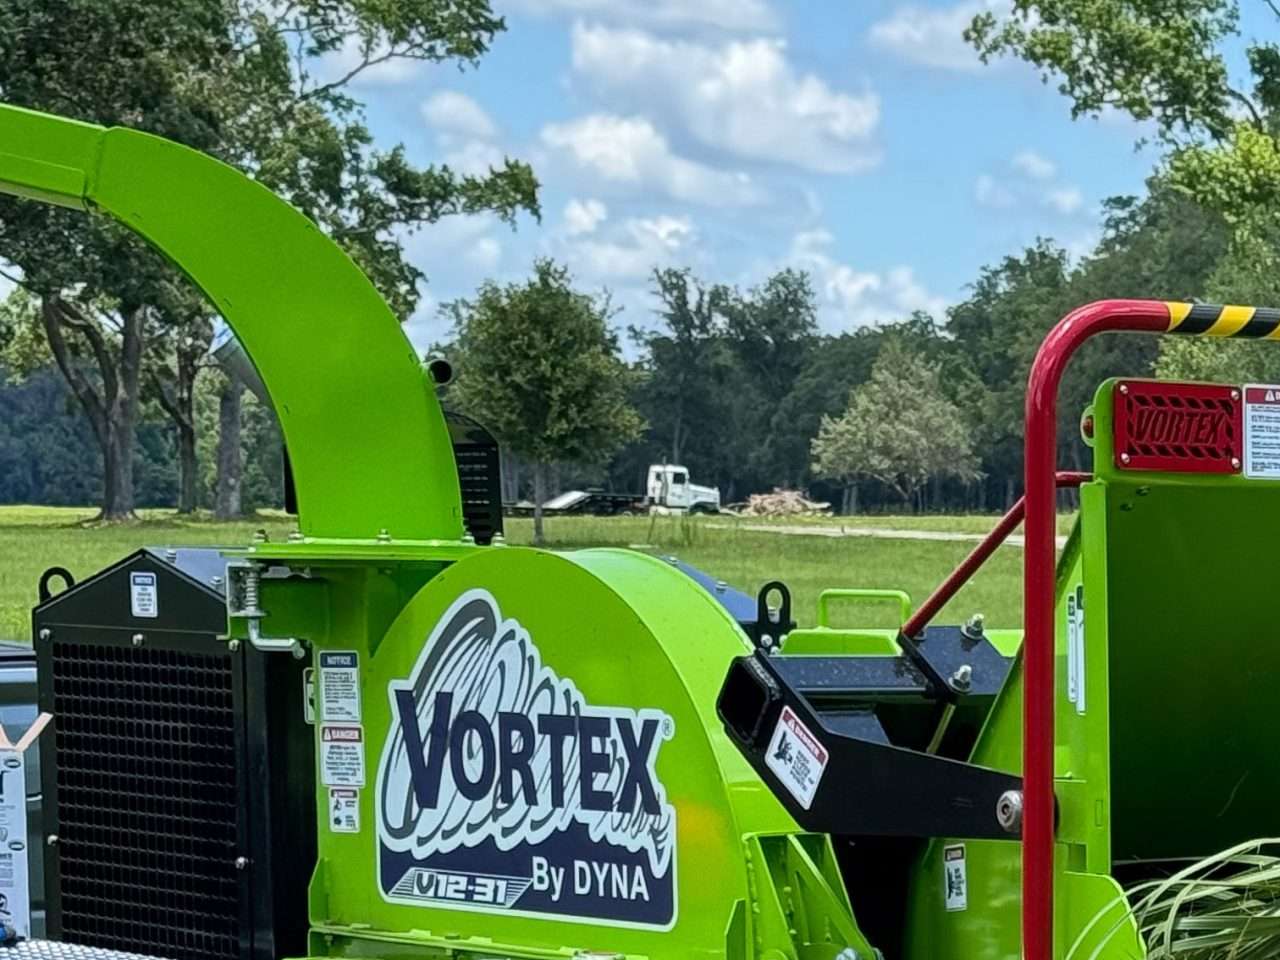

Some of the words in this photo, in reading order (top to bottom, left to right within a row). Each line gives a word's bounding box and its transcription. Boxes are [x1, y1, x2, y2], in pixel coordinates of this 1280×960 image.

[1136, 408, 1226, 444] VORTEX
[394, 689, 662, 817] VORTEX
[413, 871, 508, 903] V12-31
[532, 856, 564, 901] By
[574, 859, 650, 902] DYNA
